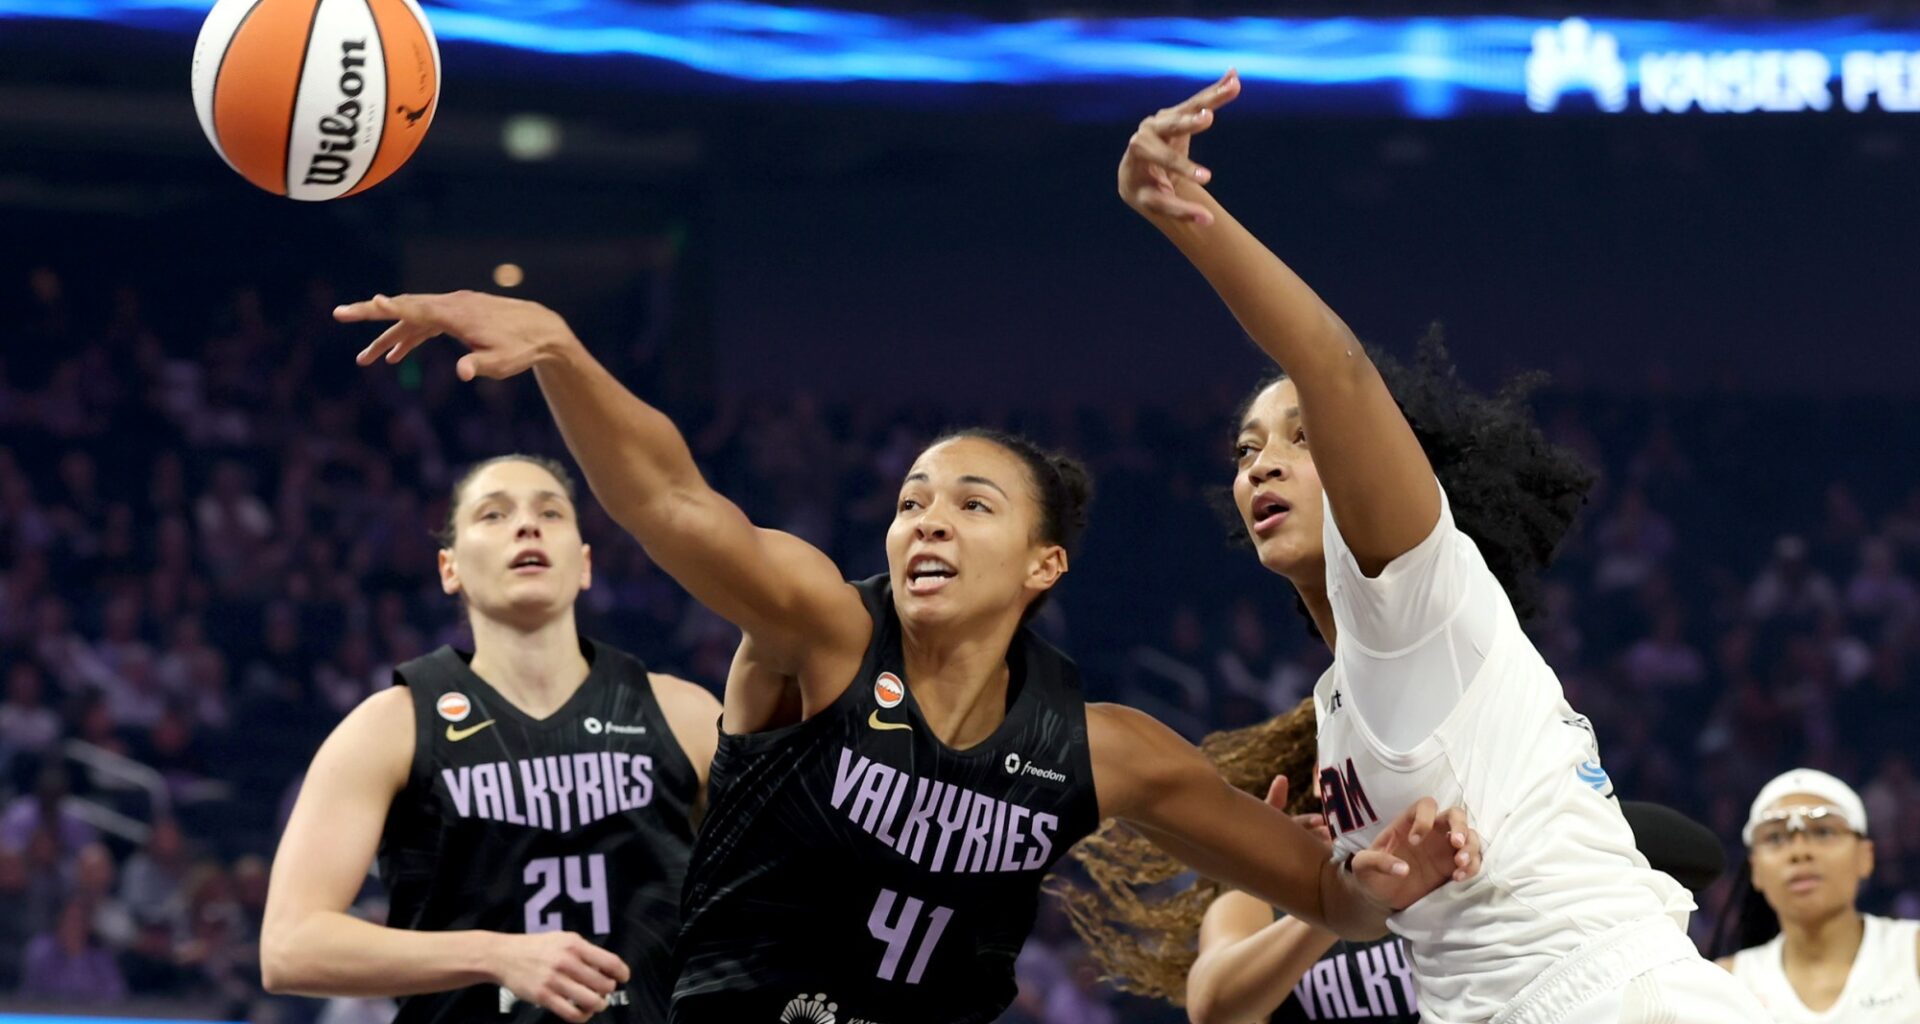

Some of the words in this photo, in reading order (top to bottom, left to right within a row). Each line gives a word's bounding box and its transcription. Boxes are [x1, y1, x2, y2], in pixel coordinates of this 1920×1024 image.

[303, 38, 366, 186] Wilson
[1640, 50, 1831, 113] KAISER
[605, 721, 646, 734] freedom
[442, 752, 653, 833] VALKYRIES
[830, 747, 1058, 872] VALKYRIES
[1020, 760, 1066, 782] freedom
[1319, 757, 1379, 841] AM
[524, 854, 610, 934] 24
[867, 888, 954, 984] 41
